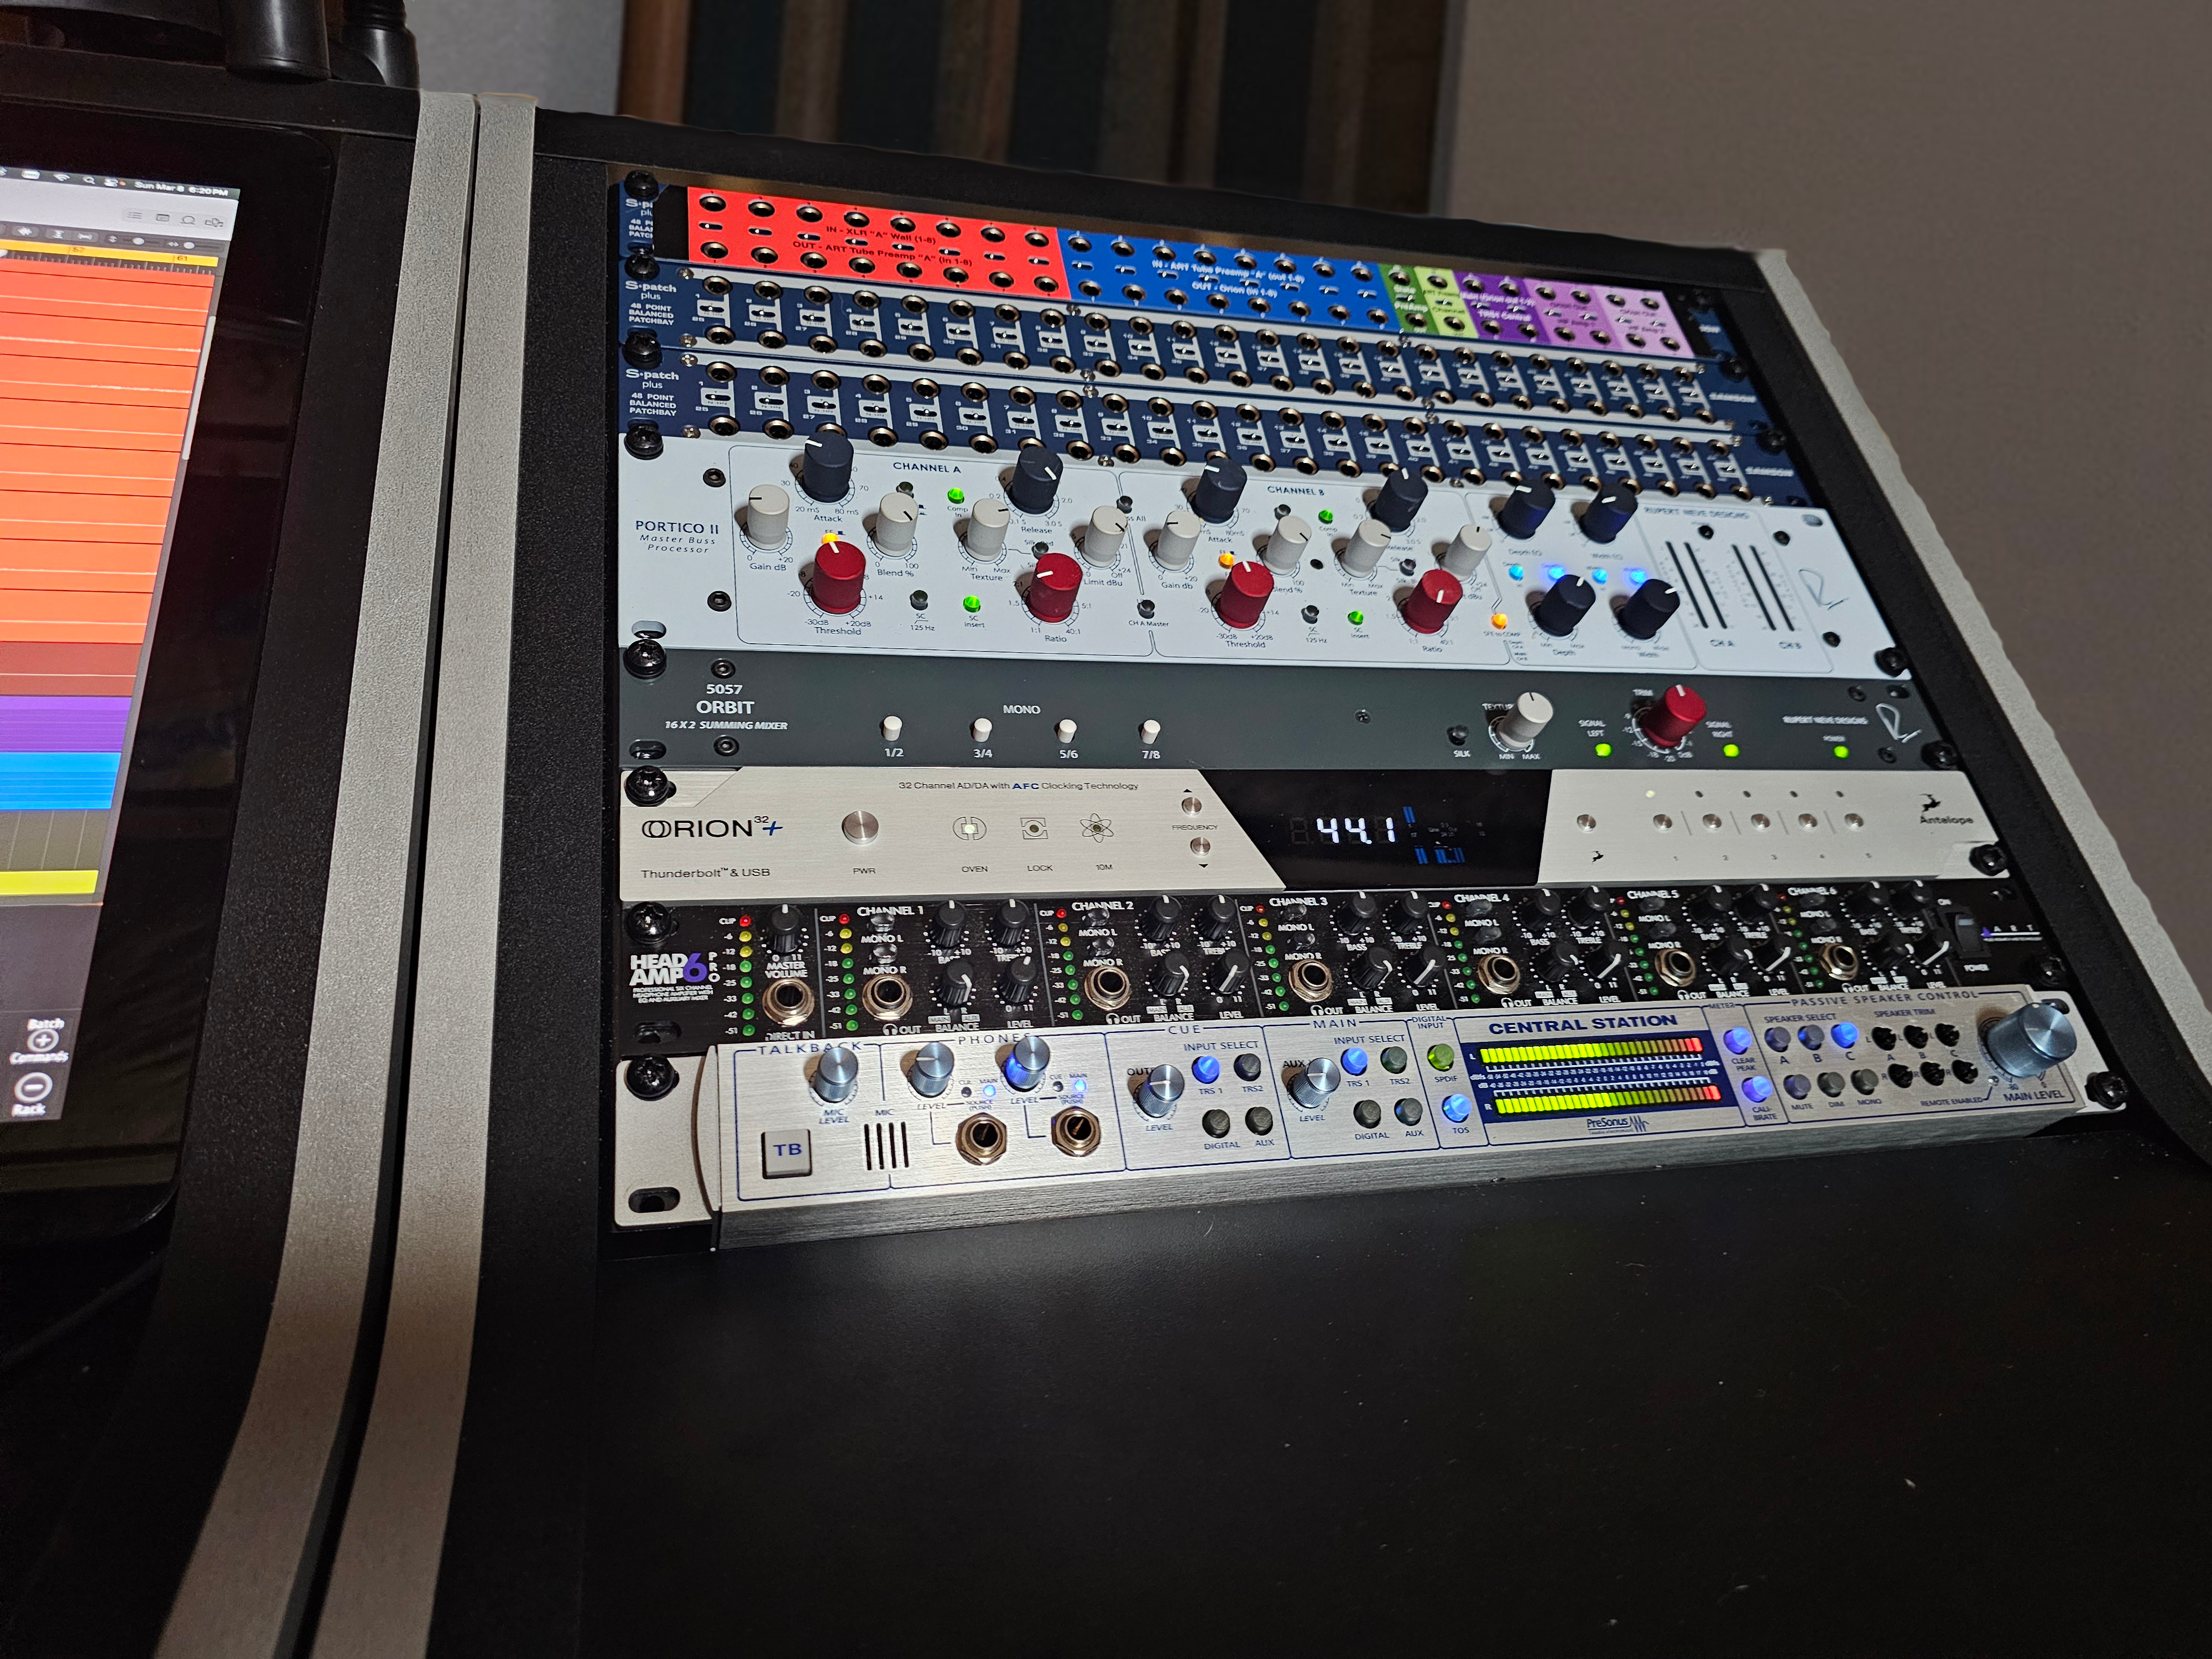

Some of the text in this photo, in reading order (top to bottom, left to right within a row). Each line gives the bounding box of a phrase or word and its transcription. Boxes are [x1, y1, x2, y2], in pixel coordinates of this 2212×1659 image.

[156, 183, 176, 191] Mar
[847, 228, 868, 236] XLR
[891, 233, 912, 242] Wall
[915, 235, 936, 244] (1-8)
[826, 244, 847, 253] ART
[850, 247, 875, 256] Tube
[878, 249, 916, 261] Preamp
[640, 291, 661, 300] plus
[628, 309, 674, 319] BALANCED
[628, 316, 674, 326] PATCHBAY
[642, 380, 663, 389] plus
[647, 393, 674, 401] POINT
[629, 399, 676, 409] BALANCED
[629, 406, 677, 416] PATCHBAY
[893, 462, 950, 473] CHANNEL
[1267, 486, 1317, 495] CHANNEL
[814, 514, 843, 523] Attack
[635, 520, 719, 534] PORTICO II
[640, 534, 716, 545] Master Buss
[648, 544, 709, 554] Processor
[814, 627, 862, 635] Threshold
[1553, 649, 1575, 658] Depth
[706, 684, 743, 695] 5057
[696, 700, 755, 714] ORBIT
[1003, 705, 1041, 714] MONO
[665, 721, 678, 729] 16
[699, 721, 753, 729] SUMMING
[754, 722, 788, 730] MIXER
[885, 748, 904, 758] 1/2
[973, 748, 993, 759] 3/4
[1060, 749, 1078, 759] 5/6
[1142, 750, 1160, 760] 7/8
[914, 782, 956, 790] Channel
[957, 782, 990, 791] AD/DA
[1041, 782, 1083, 791] Clocking
[1084, 782, 1139, 791] Technology
[1919, 815, 1974, 825] Antelope
[1317, 817, 1395, 844] 44.1
[742, 868, 770, 877] USB
[1627, 890, 1671, 899] CHANNEL
[1787, 887, 1829, 895] CHANNEL
[1269, 897, 1328, 906] CHANNEL 3
[1454, 893, 1510, 902] CHANNEL 4
[857, 906, 924, 916] CHANNEL 1
[1072, 901, 1134, 911] CHANNEL 2
[630, 954, 688, 969] HEAD
[766, 962, 806, 971] MASTER
[629, 953, 708, 986] AMP 6
[764, 969, 808, 978] VOLUME
[1791, 991, 1978, 1006] PASSIVE SPEAKER CONTROL
[1355, 1005, 1394, 1013] BALANCE
[1122, 1015, 1141, 1024] OUT
[1154, 1013, 1194, 1021] BALANCE
[1219, 1011, 1244, 1020] LEVEL
[1806, 1013, 1837, 1021] SELECT
[27, 1018, 65, 1032] Batch
[935, 1022, 979, 1032] BALANCE
[1008, 1020, 1034, 1029] LEVEL
[1313, 1019, 1357, 1029] MAIN
[1488, 1014, 1678, 1035] CENTRAL STATION
[1168, 1025, 1201, 1034] CUE
[1334, 1034, 1405, 1045] INPUT SELECT
[1184, 1041, 1259, 1051] INPUT SELECT
[1952, 1097, 1984, 1105] ENABLED
[2004, 1090, 2065, 1102] MAIN LEVEL
[1587, 1117, 1630, 1128] PreSonus
[1355, 1131, 1390, 1140] DIGITAL
[774, 1143, 802, 1156] TB
[1204, 1141, 1240, 1150] DIGITAL
